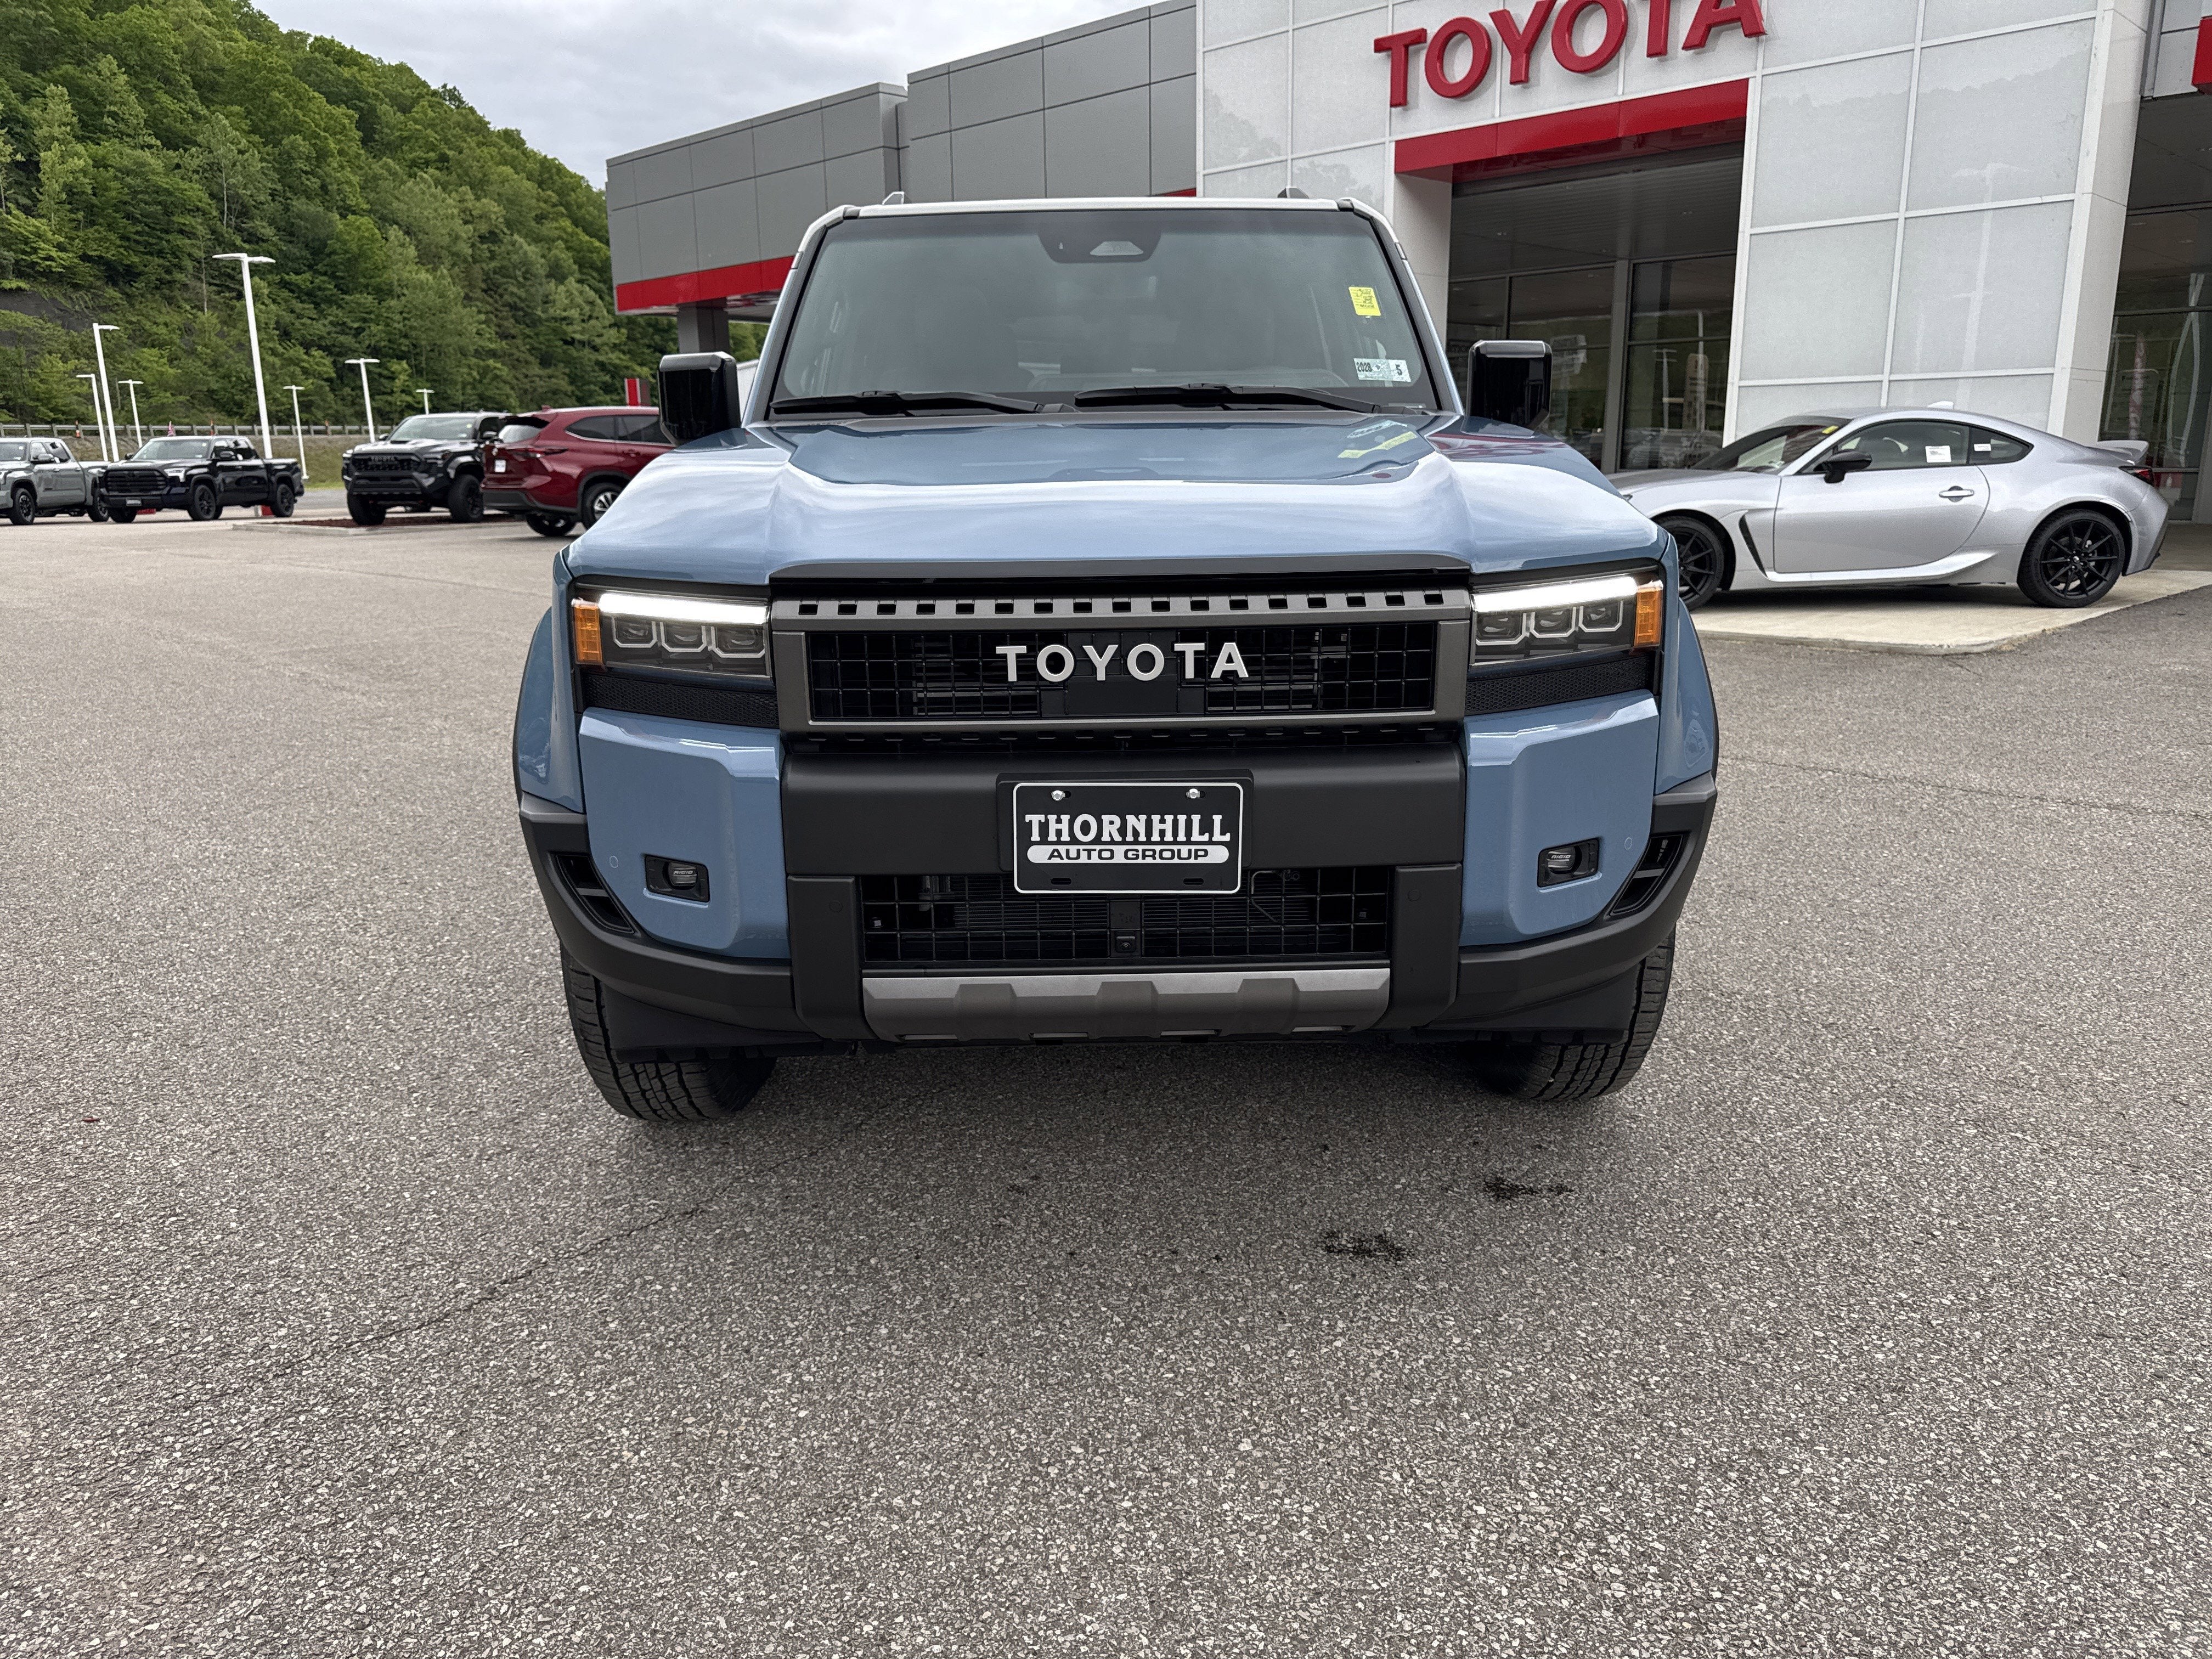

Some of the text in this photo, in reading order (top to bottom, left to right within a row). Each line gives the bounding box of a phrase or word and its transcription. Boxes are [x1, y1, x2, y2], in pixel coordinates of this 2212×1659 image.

[1395, 364, 1402, 375] 5
[996, 642, 1249, 682] TOYOTA
[1025, 814, 1231, 842] THORNHILL
[1047, 848, 1209, 861] AUTO GROUP
